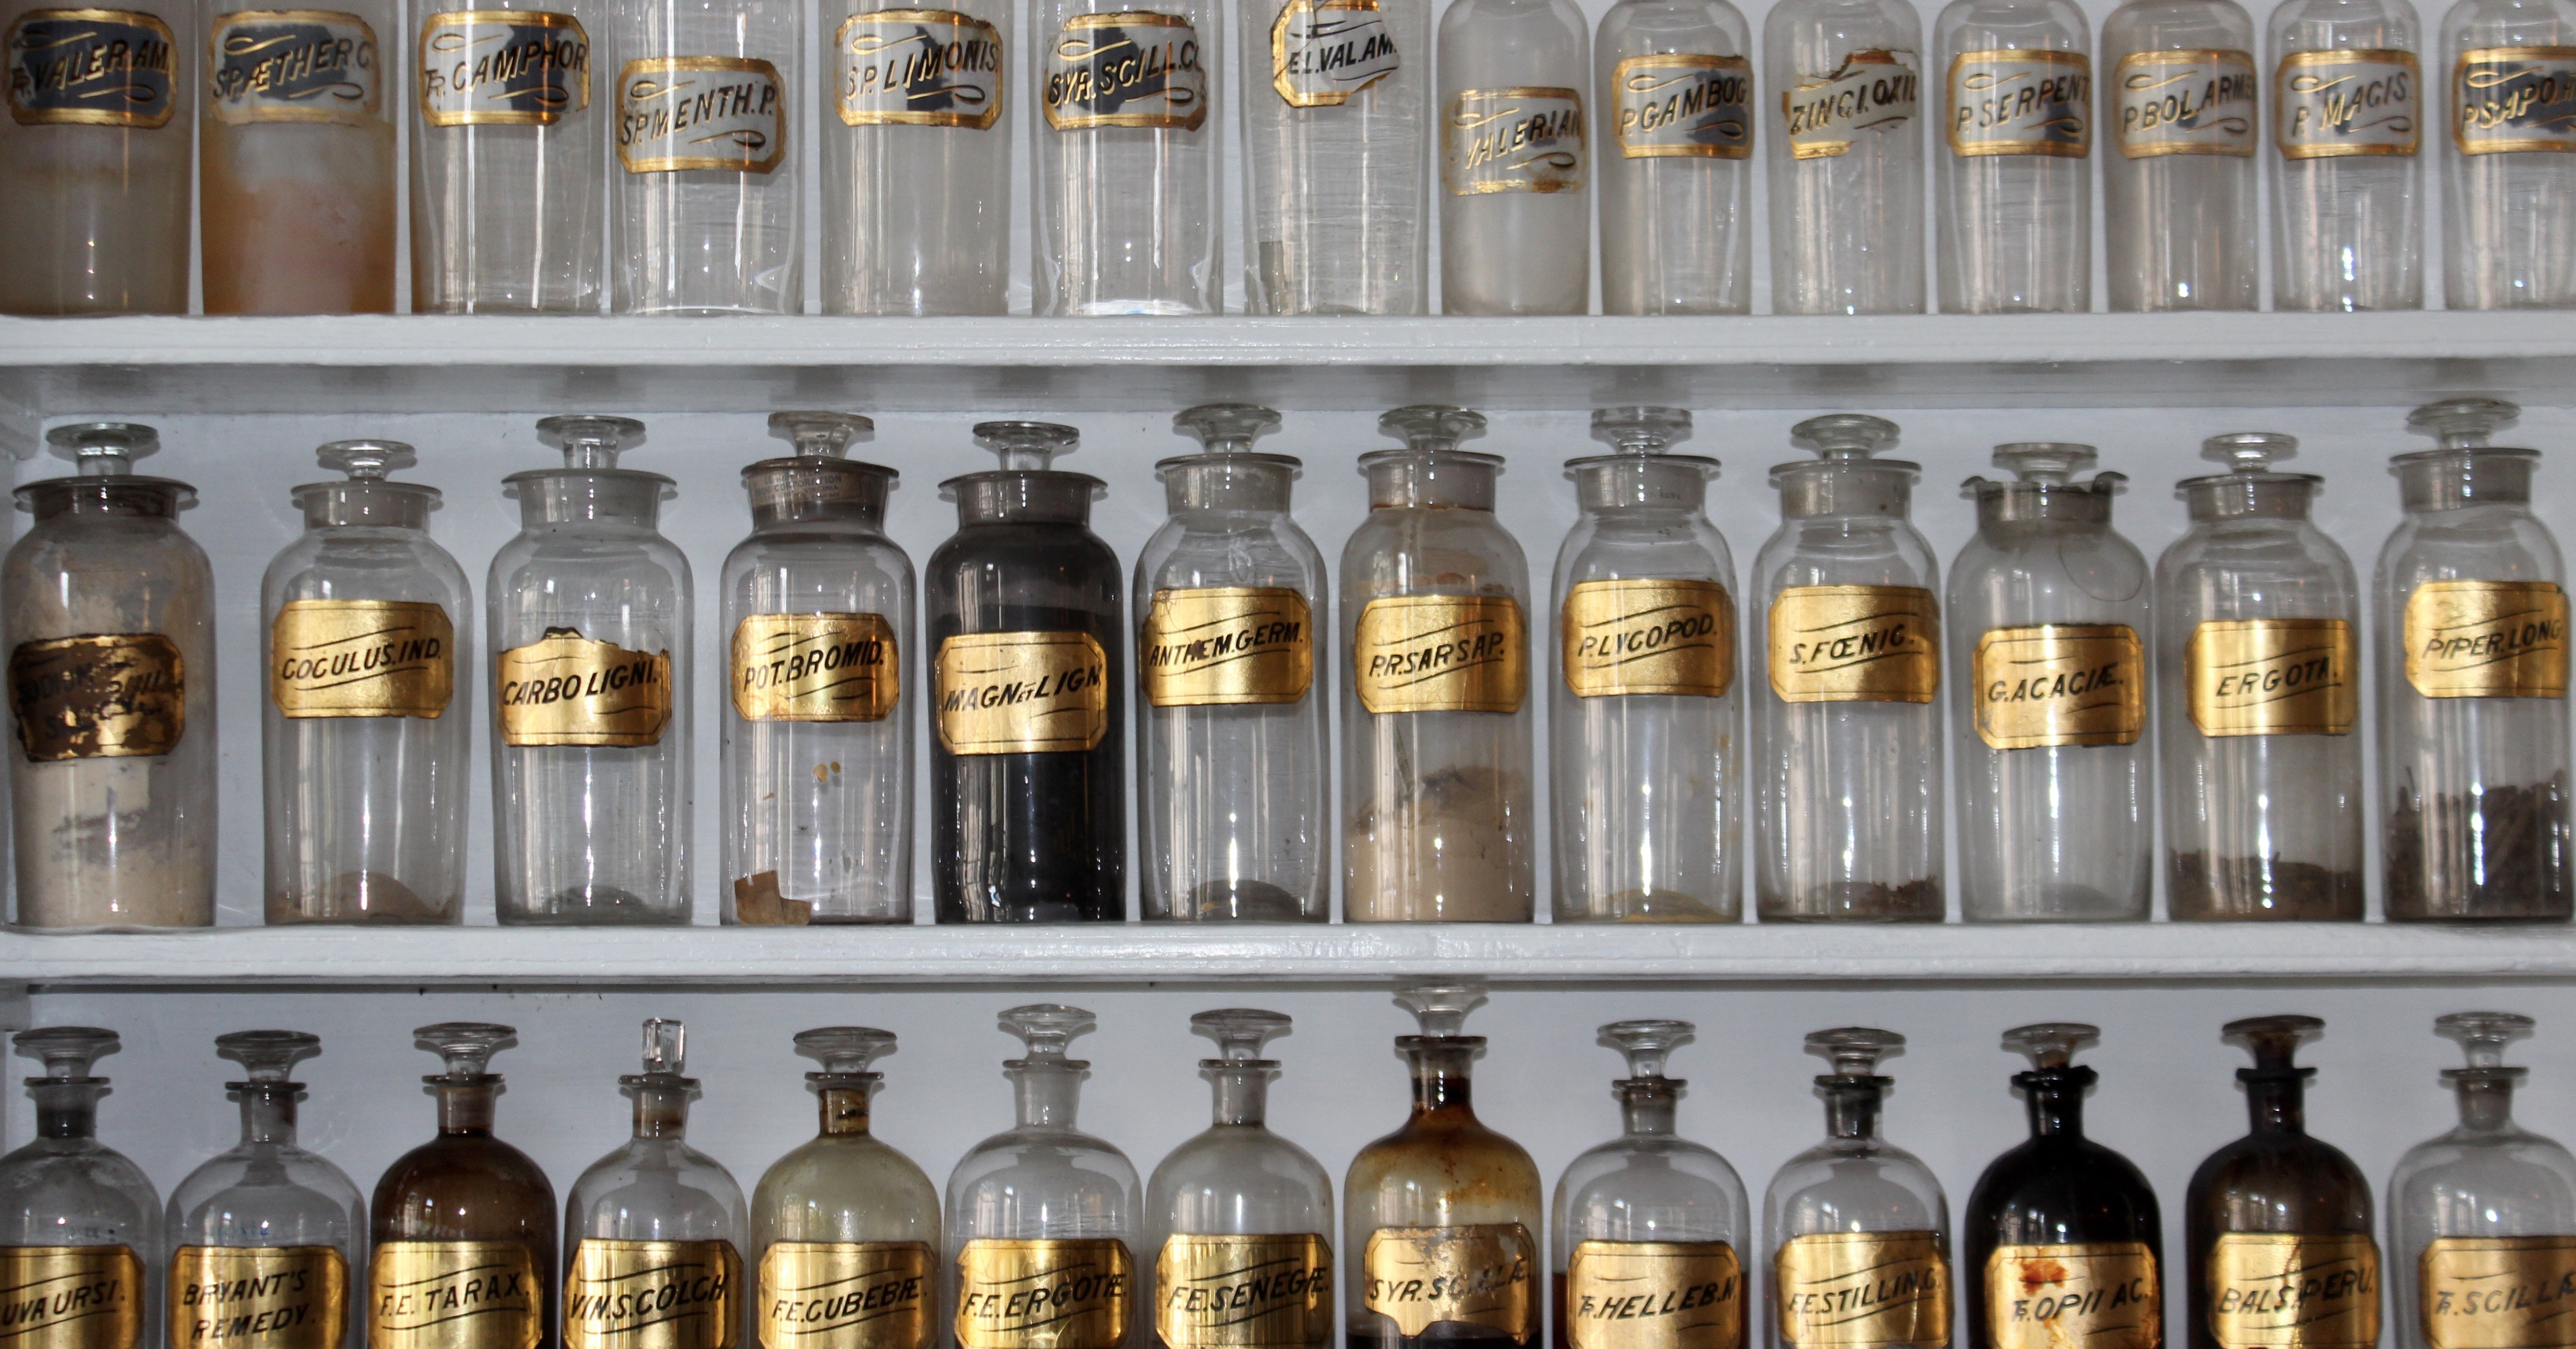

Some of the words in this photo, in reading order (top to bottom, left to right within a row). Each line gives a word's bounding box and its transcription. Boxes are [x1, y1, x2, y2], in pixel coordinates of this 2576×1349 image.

[503, 674, 580, 706] CARBO
[585, 658, 657, 697] LIGNI.
[2216, 656, 2338, 697] ERGOTA.
[3, 1297, 48, 1326] UVA
[54, 1279, 125, 1314] URSI.
[183, 1269, 308, 1306] BRYANT'S
[427, 1272, 530, 1311] TARAX.
[192, 1303, 315, 1339] REMEDY.
